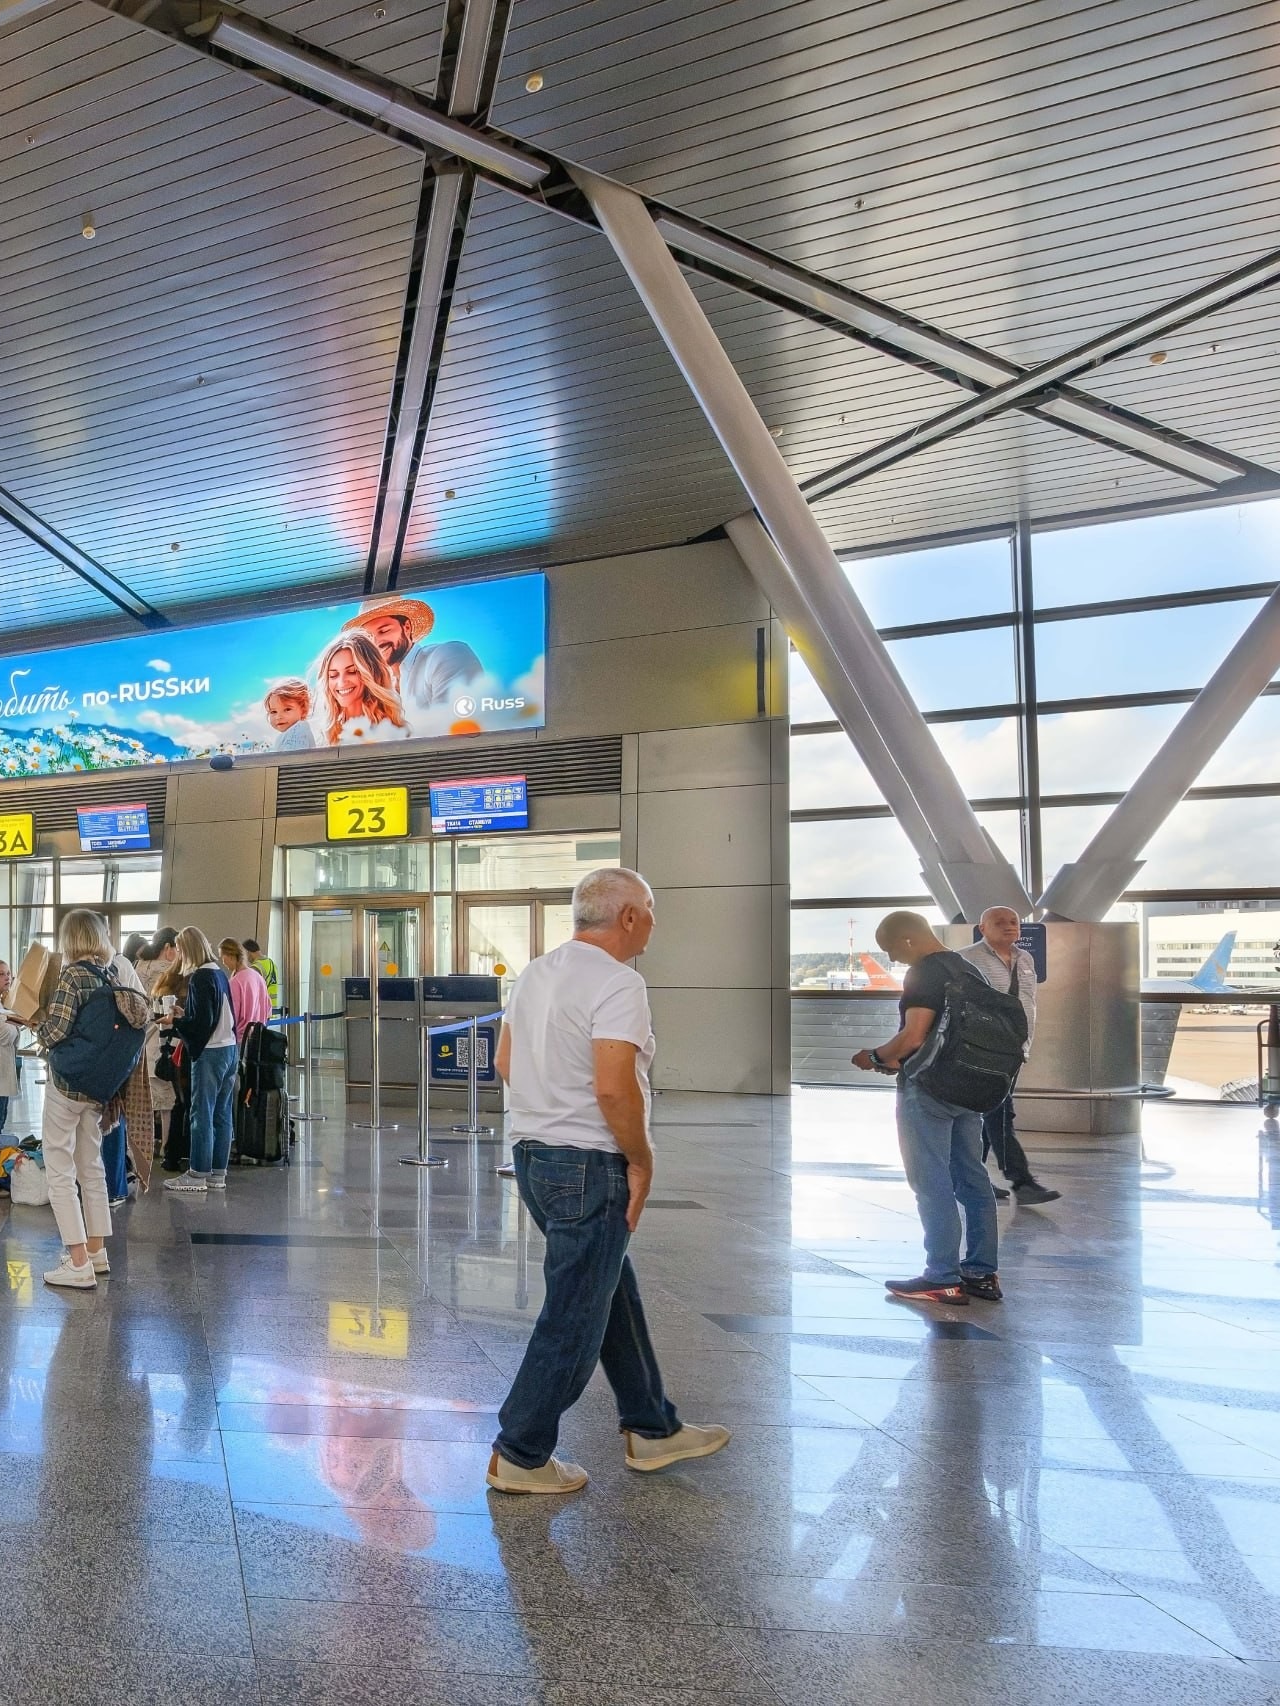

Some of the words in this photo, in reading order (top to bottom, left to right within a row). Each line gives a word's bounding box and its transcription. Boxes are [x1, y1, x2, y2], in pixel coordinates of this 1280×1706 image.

[82, 676, 211, 708] по-RUSSки
[481, 697, 525, 712] Russ
[347, 806, 386, 834] 23
